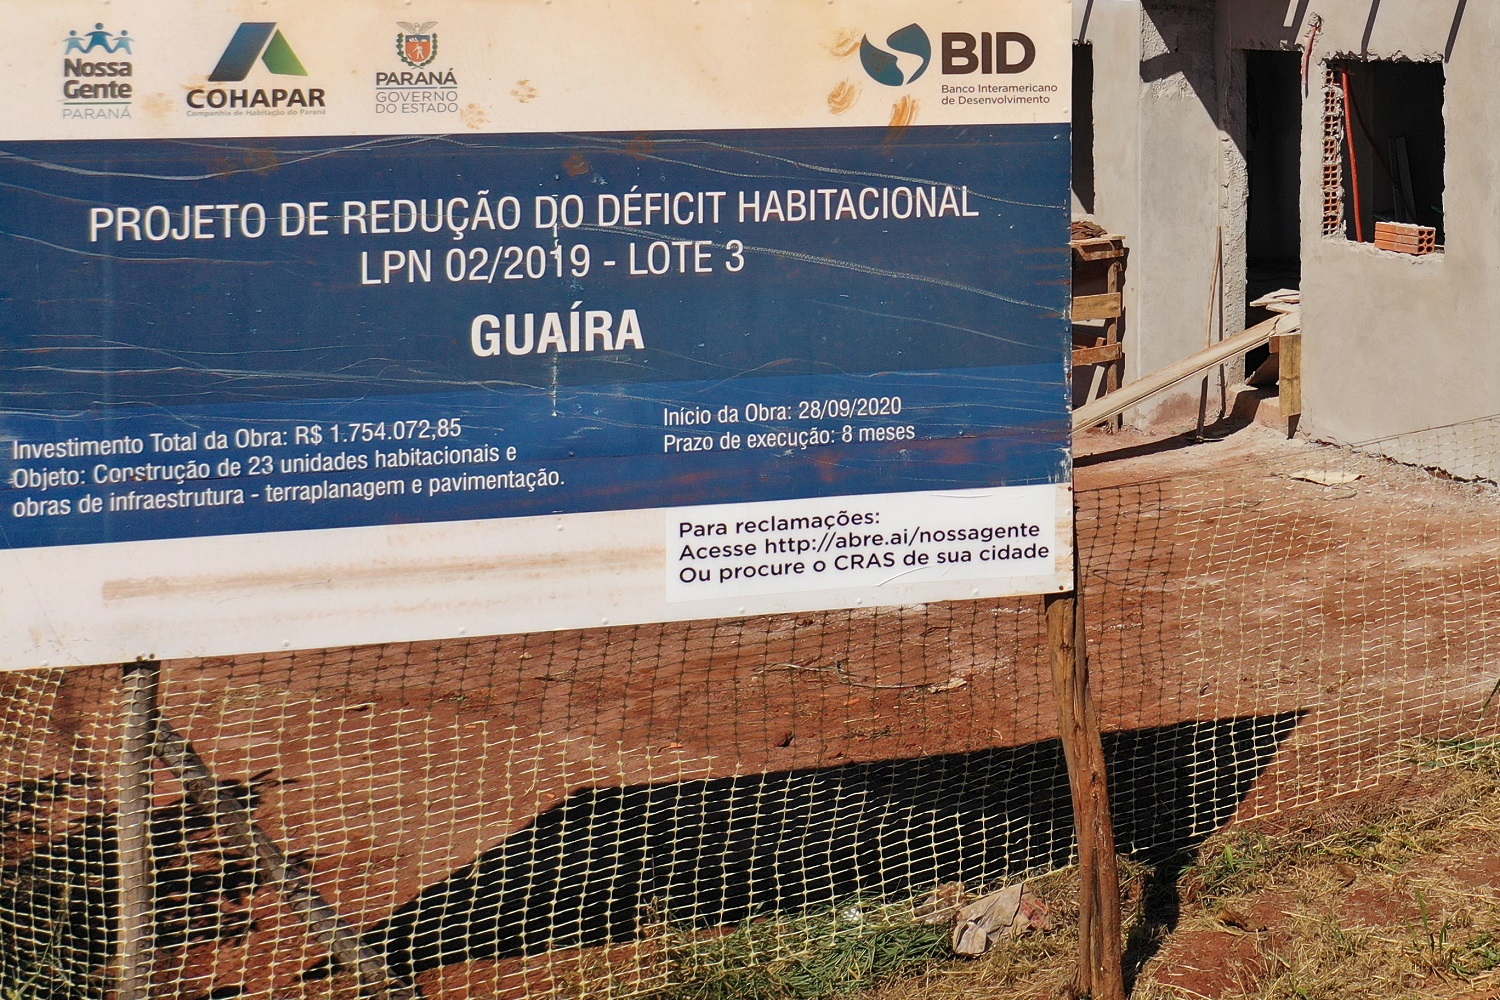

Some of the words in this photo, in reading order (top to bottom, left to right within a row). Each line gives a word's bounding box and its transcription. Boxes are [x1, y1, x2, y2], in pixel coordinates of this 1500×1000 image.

[63, 57, 132, 78] Nossa
[941, 32, 1036, 74] BID
[63, 80, 132, 99] Gente
[375, 68, 457, 86] PARANÁ
[941, 84, 975, 93] Banco
[978, 83, 1058, 92] Interamericano
[186, 87, 325, 109] COHAPAR
[375, 90, 459, 102] GOVERNO
[375, 103, 398, 113] DO
[401, 102, 459, 113] ESTADO
[941, 96, 955, 104] de
[958, 95, 1050, 104] Desenvolvimento
[62, 105, 132, 120] PARANÁ
[186, 109, 231, 118] Companhia
[245, 109, 284, 117] Habitação
[300, 108, 326, 116] Paraná
[88, 202, 263, 243] PROJETO
[280, 202, 329, 237] DE
[342, 188, 521, 240] REDUÇÃO
[534, 195, 584, 230] DO
[596, 184, 727, 227] DÉFICIT
[738, 184, 980, 225] HABITACIONAL
[359, 248, 433, 286] LPN
[445, 242, 591, 282] 02/2019
[629, 240, 714, 275] LOTE
[724, 238, 745, 273] 3
[470, 300, 645, 358] GUAÍRA
[664, 405, 712, 425] Início
[718, 406, 739, 424] da
[745, 402, 792, 422] Obra:
[799, 396, 902, 420] 28/09/2020
[13, 436, 144, 460] Investimento
[150, 430, 197, 453] Total
[204, 430, 229, 450] da
[234, 427, 287, 449] Obra:
[296, 423, 322, 446] R$
[330, 418, 462, 444] 1.754.072,85
[664, 432, 713, 453] Prazo
[719, 431, 741, 450] de
[746, 425, 835, 449] execução:
[841, 424, 853, 443] 8
[859, 423, 915, 442] meses
[13, 466, 86, 491] Objeto:
[93, 459, 211, 487] Construção
[217, 458, 242, 478] de
[248, 456, 273, 476] 23
[280, 450, 368, 474] unidades
[374, 445, 500, 469] habitacionais
[505, 446, 517, 461] e
[13, 496, 71, 518] obras
[78, 494, 103, 514] de
[109, 486, 245, 512] infraestrutura
[265, 478, 405, 504] terraplanagem
[411, 477, 422, 493] e
[429, 467, 565, 497] pavimentação.
[679, 519, 728, 538] Para
[736, 509, 880, 534] reclamações:
[679, 541, 757, 561] Acesse
[764, 522, 1040, 556] http://abre.ai/nossagente
[679, 565, 711, 583] Ou
[719, 559, 805, 584] procure
[815, 559, 826, 572] o
[834, 552, 895, 571] CRAS
[903, 549, 929, 566] de
[936, 548, 972, 564] sua
[979, 543, 1049, 562] cidade
